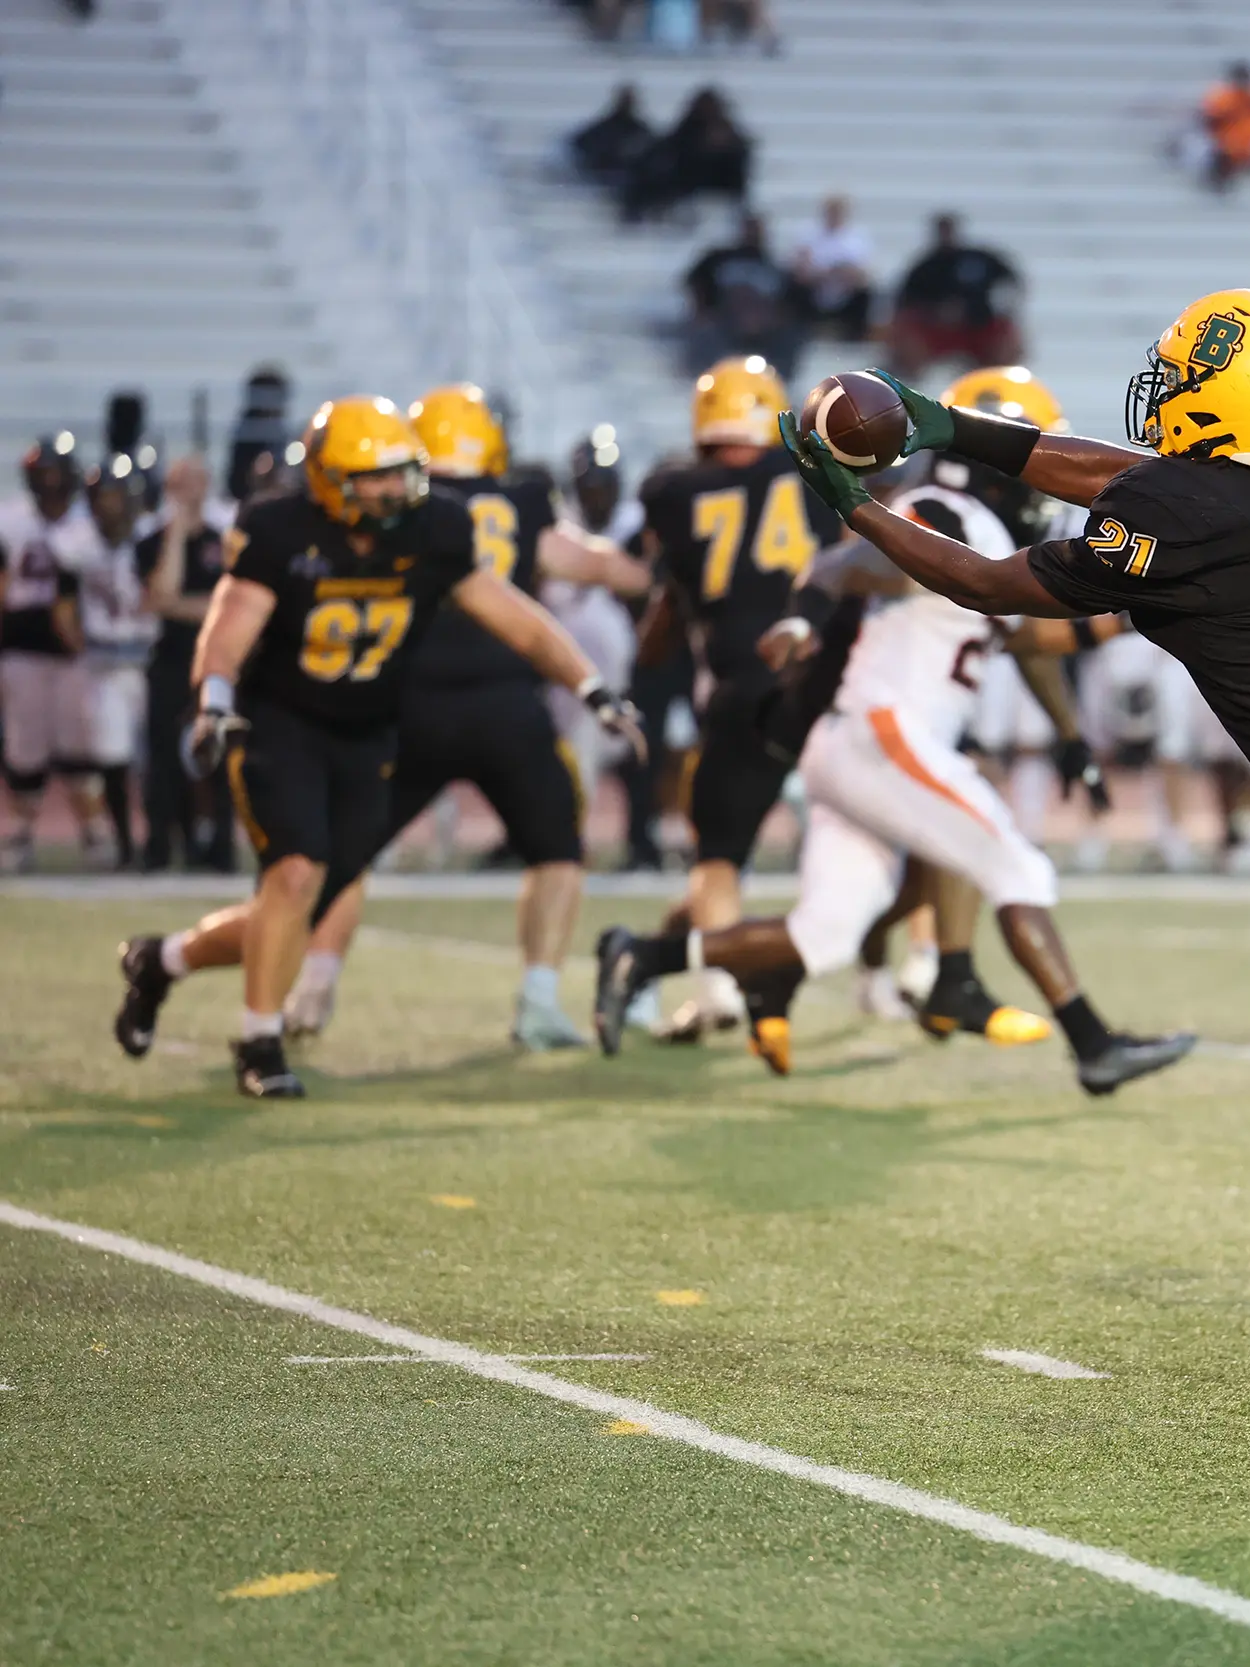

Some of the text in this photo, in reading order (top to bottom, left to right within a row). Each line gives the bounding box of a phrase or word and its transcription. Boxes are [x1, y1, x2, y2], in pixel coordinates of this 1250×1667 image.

[1190, 312, 1246, 372] B
[692, 473, 821, 600] 74
[1085, 517, 1157, 577] 21
